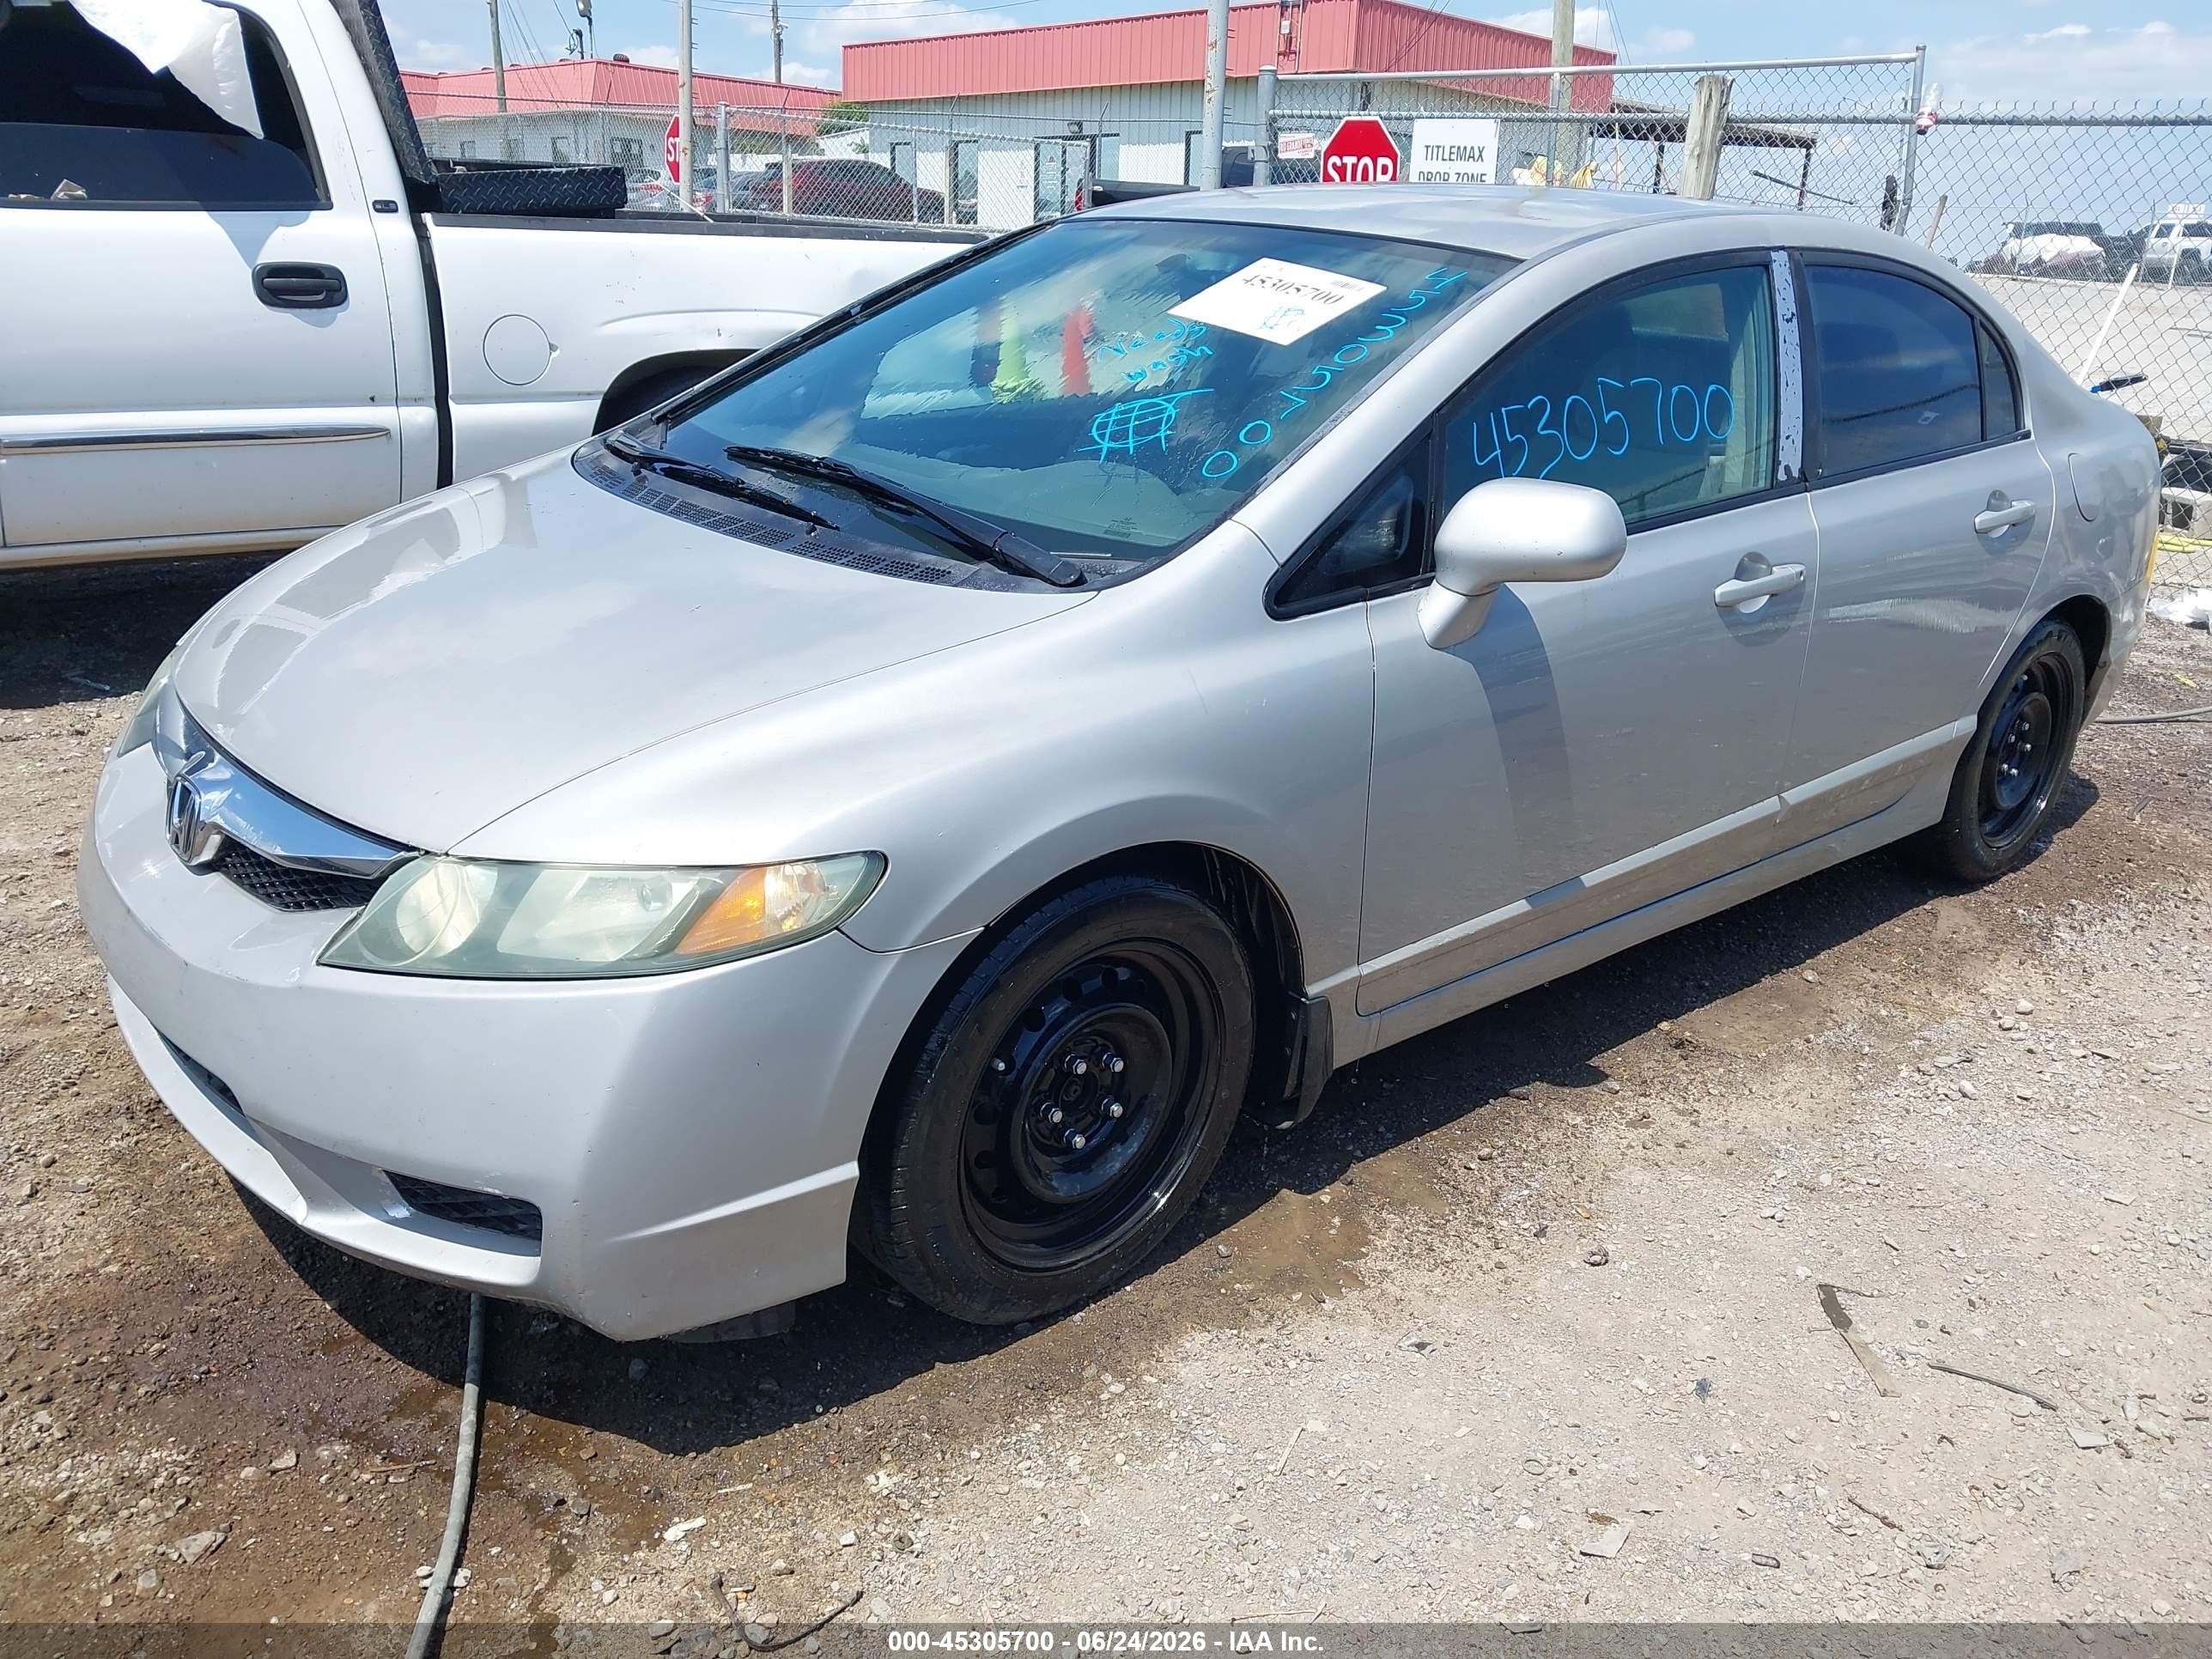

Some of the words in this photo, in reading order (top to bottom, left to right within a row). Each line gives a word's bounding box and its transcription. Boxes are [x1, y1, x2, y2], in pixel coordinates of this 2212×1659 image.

[667, 137, 680, 161] ST
[1424, 144, 1486, 163] TITLEMAX
[1327, 155, 1395, 182] STOP
[1242, 274, 1345, 306] 45305700
[1473, 376, 1735, 479] 45305700
